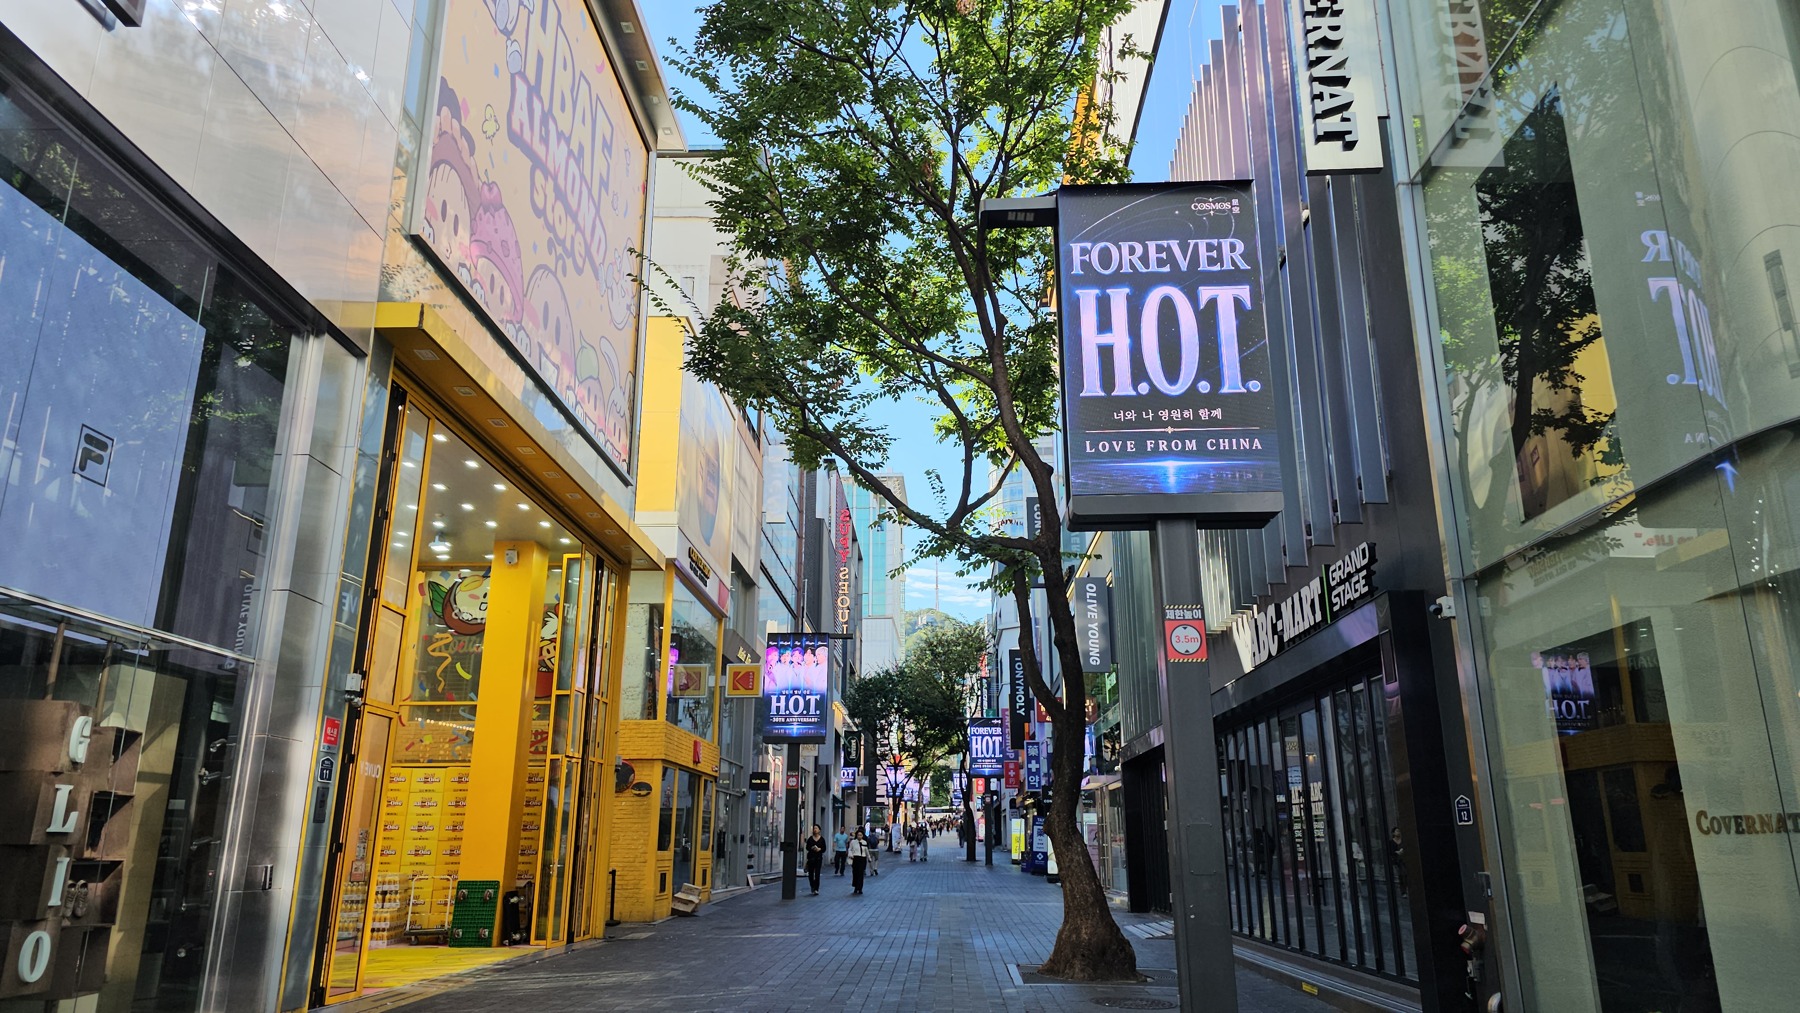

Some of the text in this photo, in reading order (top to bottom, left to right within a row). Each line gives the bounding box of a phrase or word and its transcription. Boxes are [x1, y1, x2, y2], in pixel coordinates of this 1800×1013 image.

[524, 0, 614, 197] HBAF
[510, 74, 607, 262] ALMOND
[1191, 202, 1231, 211] COSMOS
[1070, 238, 1251, 275] FOREVER
[1075, 285, 1262, 397] H.O.T.
[1113, 408, 1222, 421] 너와 나 영원히 함께
[1085, 438, 1263, 453] LOVE FROM CHINA
[1329, 541, 1370, 586] GRAND
[1332, 570, 1369, 612] STAGE
[1086, 583, 1100, 666] OLIVE YOUNG
[1166, 610, 1202, 619] 제한높이
[1250, 577, 1322, 669] ABC-MART
[1175, 634, 1199, 643] 3.5m
[769, 695, 820, 715] H.O.T.
[970, 727, 1002, 735] FOREVER
[971, 736, 1003, 758] H.O.T.
[1461, 811, 1468, 820] 12
